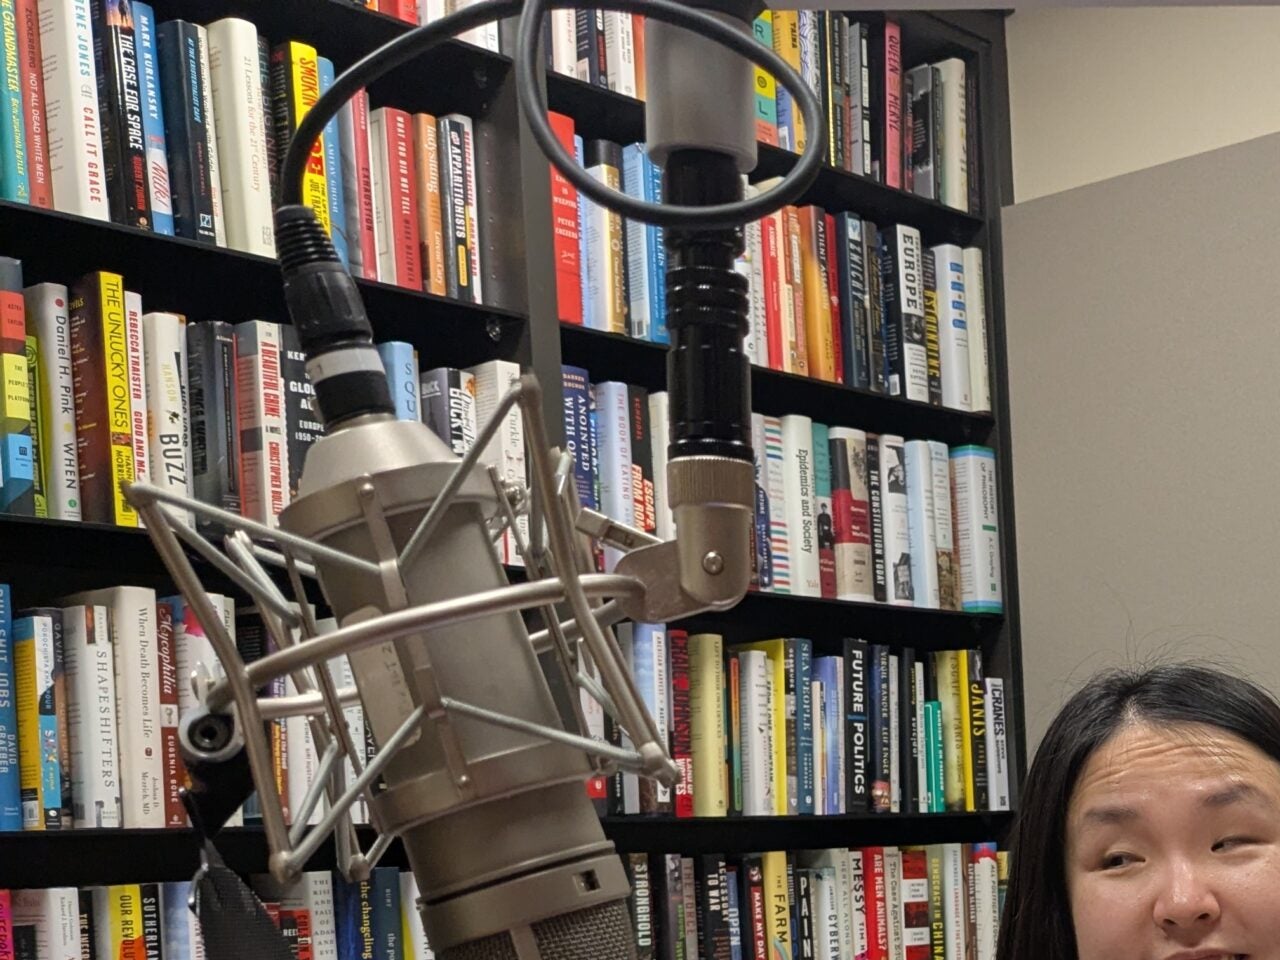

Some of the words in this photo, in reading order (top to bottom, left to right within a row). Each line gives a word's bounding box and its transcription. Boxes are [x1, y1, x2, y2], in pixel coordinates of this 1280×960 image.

[120, 34, 133, 53] THE
[140, 15, 150, 48] MARK
[2, 11, 19, 92] GRANDMASTER
[78, 35, 90, 76] JONES
[123, 57, 135, 84] CASE
[144, 53, 158, 119] KURLANSKY
[31, 92, 39, 107] ALL
[126, 89, 138, 110] FOR
[32, 109, 41, 131] DEAD
[83, 107, 95, 136] CALL
[128, 114, 143, 150] SPACE
[34, 135, 42, 162] WHITE
[87, 143, 97, 157] IT
[36, 163, 44, 183] MEN
[88, 162, 101, 202] GRACE
[903, 233, 917, 309] EUROPE
[106, 281, 119, 308] THE
[55, 315, 67, 360] Daniel
[108, 312, 125, 383] UNLUCKY
[129, 311, 139, 353] REBECCA
[925, 290, 939, 376] ASTOUNDING
[59, 365, 70, 381] H.
[131, 355, 142, 400] TRAISTER
[262, 349, 279, 390] BEAUTIFUL
[60, 385, 72, 414] Pink
[112, 385, 128, 428] ONES
[564, 397, 574, 435] WITH
[134, 411, 144, 435] GOOD
[577, 395, 590, 471] ANOINTED
[135, 438, 145, 458] AND
[159, 433, 186, 485] BUZZ
[620, 447, 627, 458] OF
[63, 443, 76, 490] WHEN
[620, 464, 629, 500] EATING
[632, 464, 642, 498] FROM
[796, 449, 813, 496] Epidemics
[643, 478, 655, 529] ESCAPE
[801, 499, 811, 517] and
[801, 519, 813, 553] Society
[871, 490, 882, 555] CONSTITUTION
[876, 559, 885, 585] TODAY
[138, 607, 148, 638] When
[54, 623, 63, 663] GAVIN
[139, 640, 150, 669] Death
[158, 609, 174, 695] Mycophilia
[801, 643, 809, 672] SEA
[140, 671, 152, 716] Becomes
[852, 649, 864, 713] FUTURE
[96, 651, 115, 788] SHAPESHIFTERS
[802, 676, 812, 731] PEOPLE
[971, 684, 986, 736] JANIS
[991, 688, 1004, 736] CRANES
[142, 718, 152, 738] Life
[7, 734, 17, 764] DAVID
[167, 735, 177, 775] EUGENIA
[853, 722, 865, 794] POLITICS
[874, 854, 882, 873] ARE
[360, 881, 370, 898] the
[709, 890, 720, 911] WAR
[853, 858, 865, 914] MESSY
[875, 876, 883, 899] MEN
[119, 895, 132, 915] OUR
[635, 864, 651, 946] STRONGHOLD
[753, 892, 761, 919] MAKE
[774, 894, 788, 943] FARM
[800, 877, 811, 958] PAIN
[360, 901, 374, 959] changeling
[388, 933, 396, 947] the
[756, 922, 763, 939] MY
[876, 901, 886, 950] ANIMALS?
[757, 940, 765, 959] DAY
